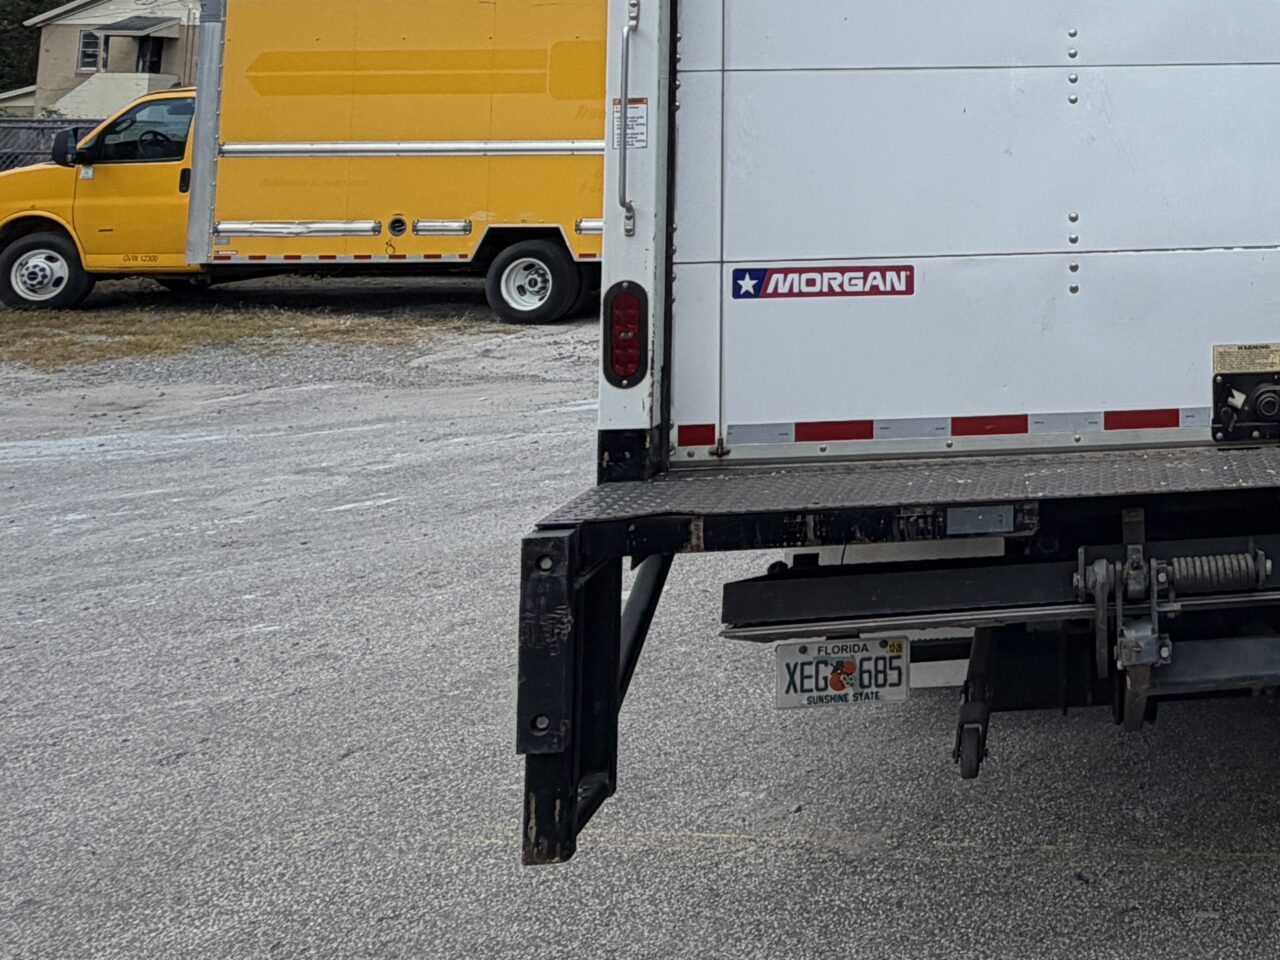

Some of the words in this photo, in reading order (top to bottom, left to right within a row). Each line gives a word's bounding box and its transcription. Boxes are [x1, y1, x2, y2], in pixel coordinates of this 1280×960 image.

[766, 271, 907, 294] MORGAN
[817, 643, 869, 655] FLORIDA
[785, 659, 829, 694] XEG
[858, 655, 902, 689] 685
[806, 693, 849, 705] SUNSHINE
[852, 691, 880, 701] STATE
